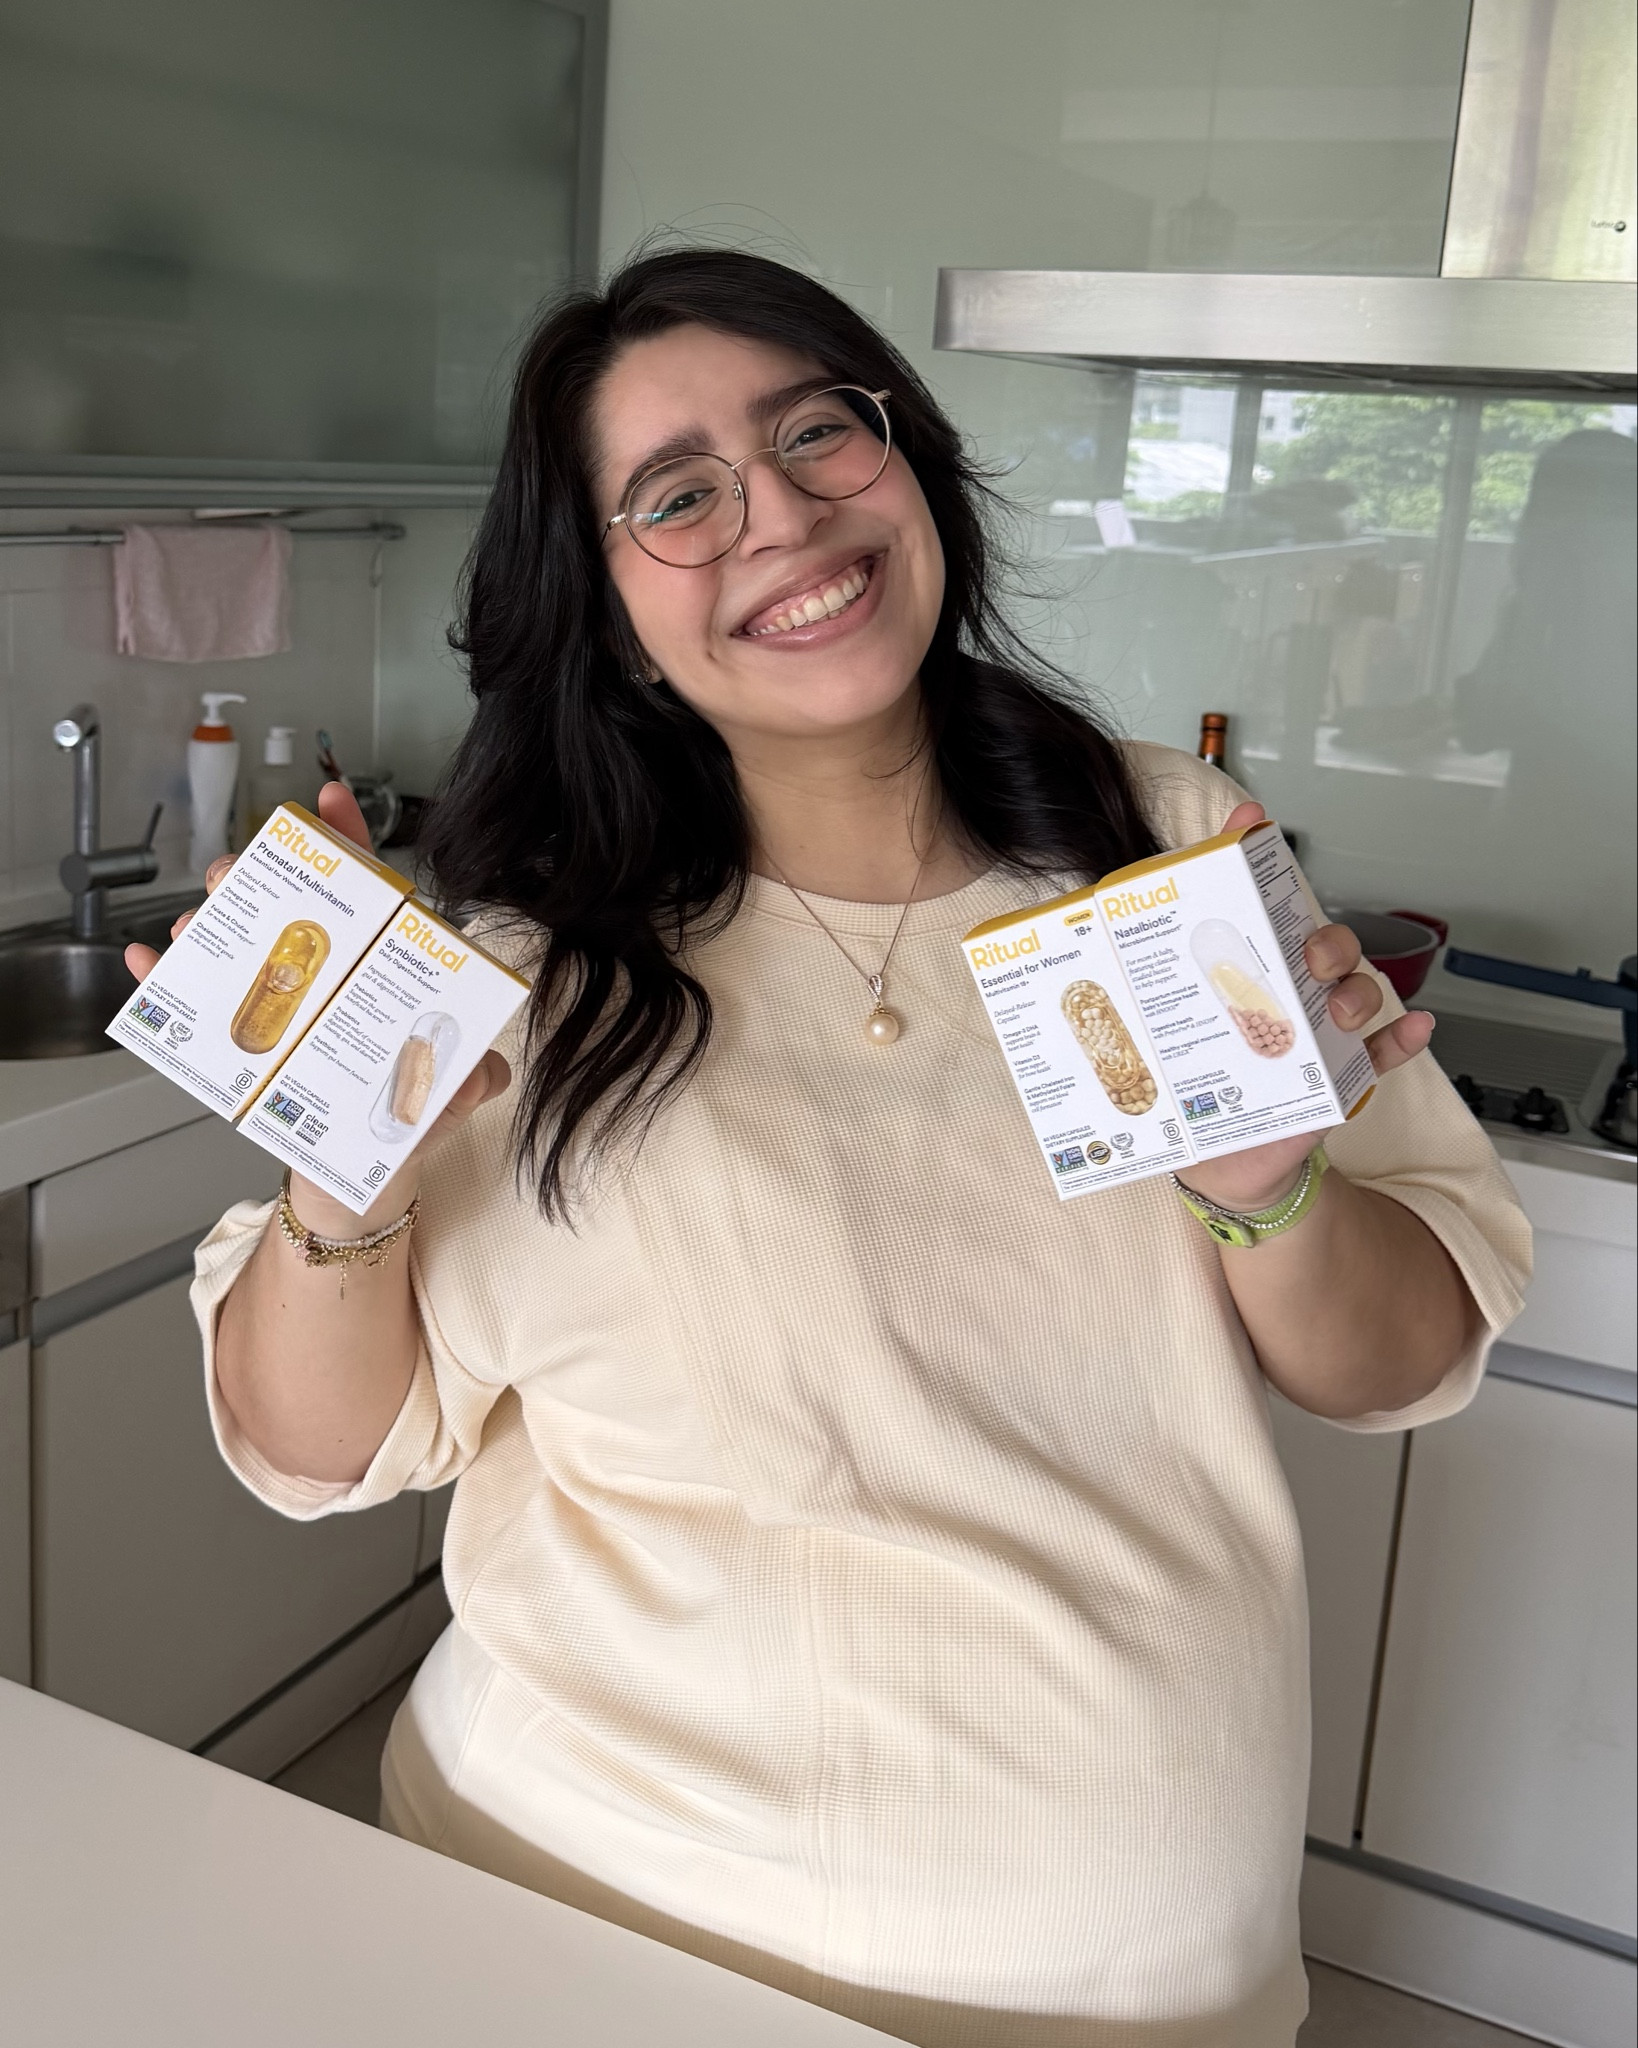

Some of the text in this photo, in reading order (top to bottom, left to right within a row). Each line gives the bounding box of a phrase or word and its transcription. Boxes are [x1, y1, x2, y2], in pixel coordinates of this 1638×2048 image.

[267, 815, 342, 878] Ritual
[249, 852, 274, 872] Essential
[282, 875, 303, 893] Women
[256, 841, 355, 917] Prenatal Multivitamin
[1102, 877, 1180, 921] Ritual
[247, 902, 259, 913] DHA
[1067, 912, 1090, 924] WOMEN
[1074, 925, 1092, 937] 18+
[396, 912, 469, 973] Ritual
[969, 928, 1041, 971] Ritual
[1118, 934, 1155, 949] Microbiome
[378, 948, 393, 962] Daily
[392, 958, 417, 979] Digestive
[980, 949, 1081, 989] Essential for Women
[367, 964, 396, 987] Ingredients
[400, 989, 421, 1005] support
[376, 981, 398, 999] digestive
[985, 983, 1020, 998] Multivitamin
[1171, 986, 1187, 995] mood
[157, 986, 174, 999] VEGAN
[173, 997, 197, 1015] CAPSULES
[1182, 990, 1199, 999] health
[146, 986, 166, 1001] DIETARY
[165, 999, 196, 1023] SUPPLEMENT
[154, 1006, 170, 1019] NON
[128, 1007, 160, 1032] VERIFIED
[150, 1010, 166, 1023] GMO
[374, 1008, 390, 1020] growth
[350, 1026, 364, 1036] relief
[1151, 1022, 1176, 1033] Digestive
[1176, 1017, 1193, 1025] health
[1014, 1057, 1032, 1066] Vitamin
[238, 1075, 249, 1087] B
[1041, 1078, 1064, 1089] Chelated
[1175, 1075, 1230, 1094] DIETARY SUPPLEMENT
[1180, 1077, 1198, 1085] VEGAN
[1199, 1069, 1225, 1081] CAPSULES
[280, 1079, 300, 1095] DIETARY
[299, 1093, 329, 1116] SUPPLEMENT
[290, 1078, 307, 1092] VEGAN
[306, 1090, 330, 1108] CAPSULES
[1199, 1097, 1215, 1105] GMO
[263, 1102, 295, 1126] VERIFIED
[285, 1104, 300, 1117] GMO
[288, 1100, 303, 1113] NON
[301, 1118, 324, 1138] label
[305, 1113, 329, 1132] clean
[1066, 1125, 1091, 1136] CAPSULES
[1045, 1130, 1096, 1148] DIETARY SUPPLEMENT
[1067, 1151, 1082, 1160] GMO
[1090, 1147, 1107, 1158] USP
